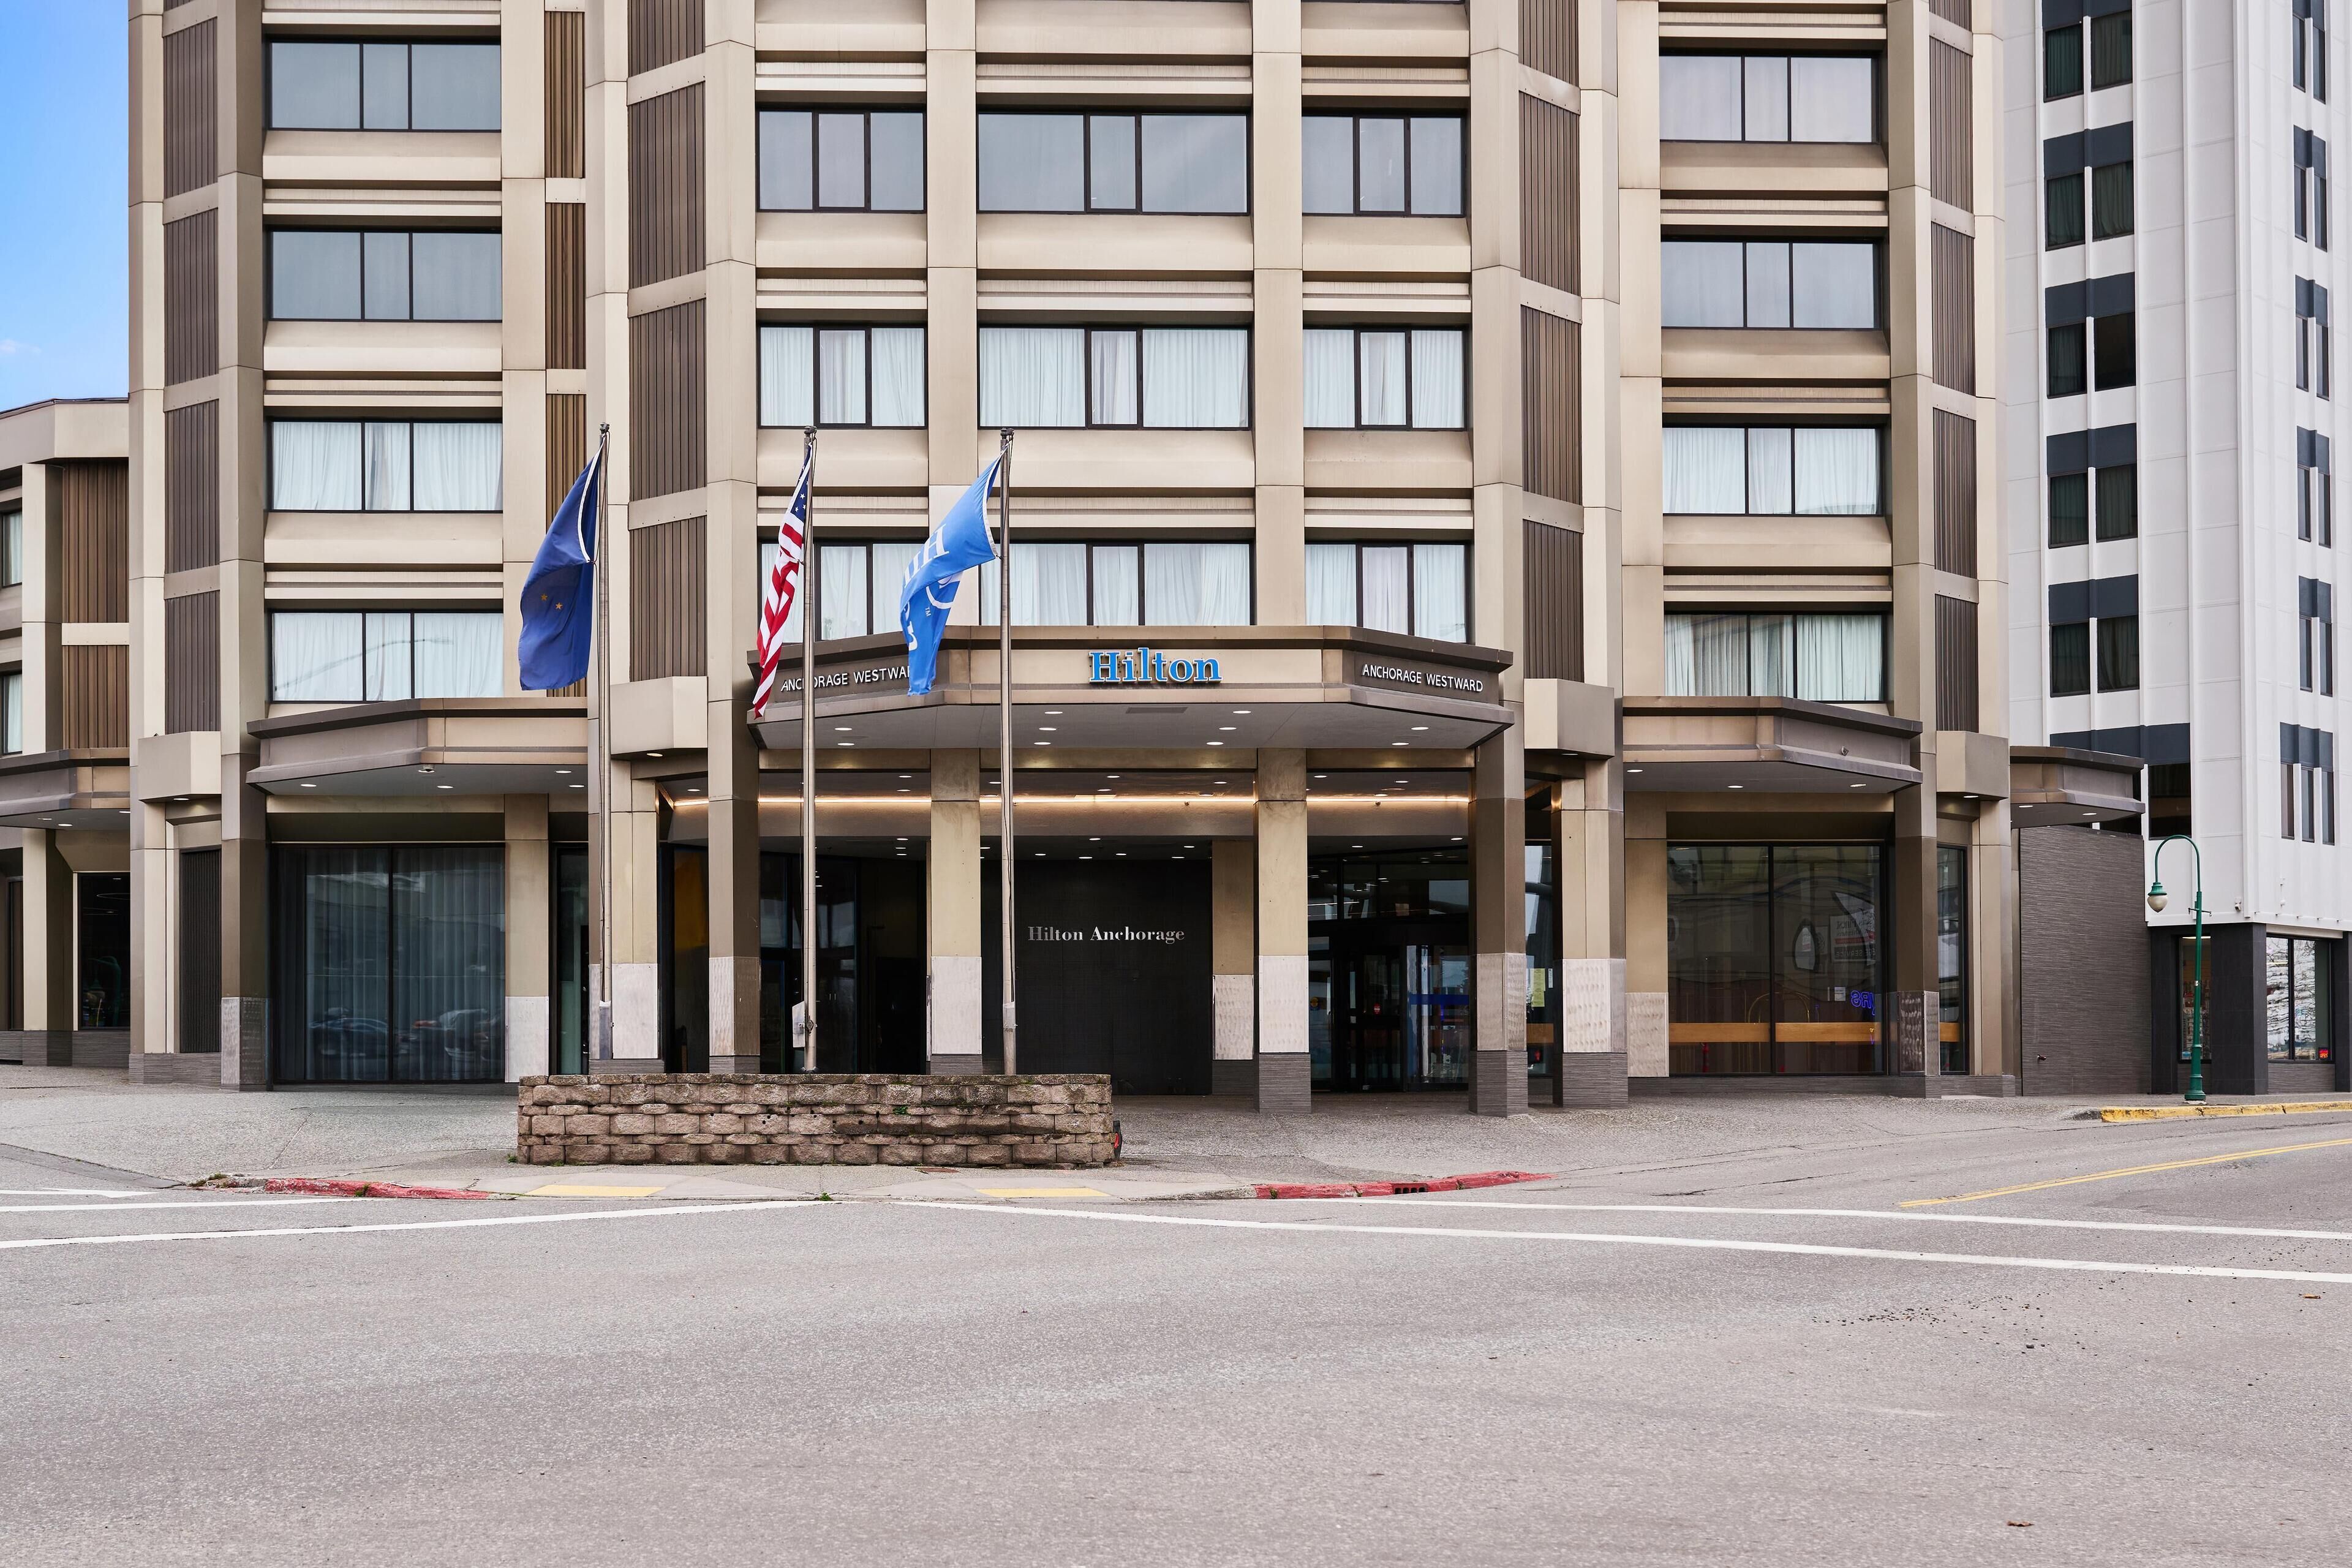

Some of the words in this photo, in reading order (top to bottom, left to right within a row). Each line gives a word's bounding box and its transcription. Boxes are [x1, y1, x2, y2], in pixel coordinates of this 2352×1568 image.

[780, 673, 848, 692] ANCRAGE
[853, 665, 910, 683] WESTWA
[1088, 647, 1223, 682] Hilton
[1362, 663, 1422, 684] ANCHORAGE
[1426, 673, 1483, 692] WESTWARD
[1028, 926, 1084, 941] Hilton
[1090, 926, 1185, 944] Anchorage
